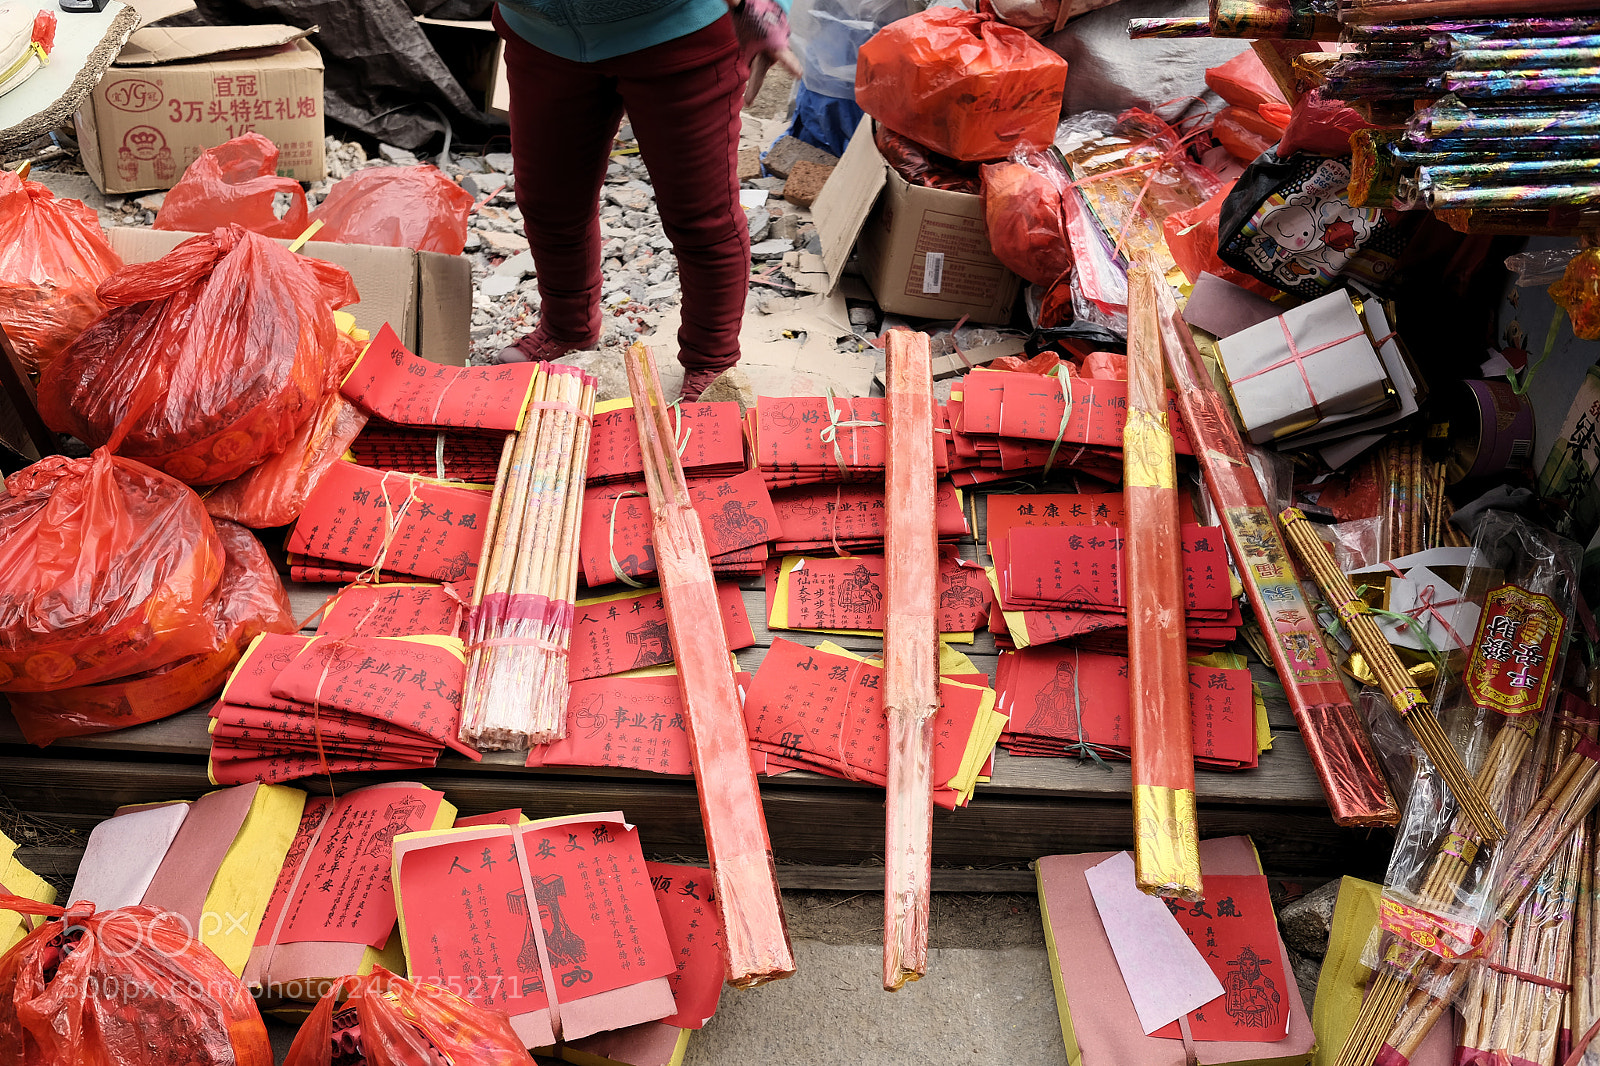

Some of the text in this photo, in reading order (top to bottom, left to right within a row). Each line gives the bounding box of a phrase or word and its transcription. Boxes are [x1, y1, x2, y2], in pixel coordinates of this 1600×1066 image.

[213, 75, 258, 98] 宜冠
[168, 97, 316, 123] 3万头特红礼炮
[1017, 502, 1111, 519] 健康长寿
[1258, 562, 1308, 626] 全家福
[609, 705, 686, 733] 事业有成
